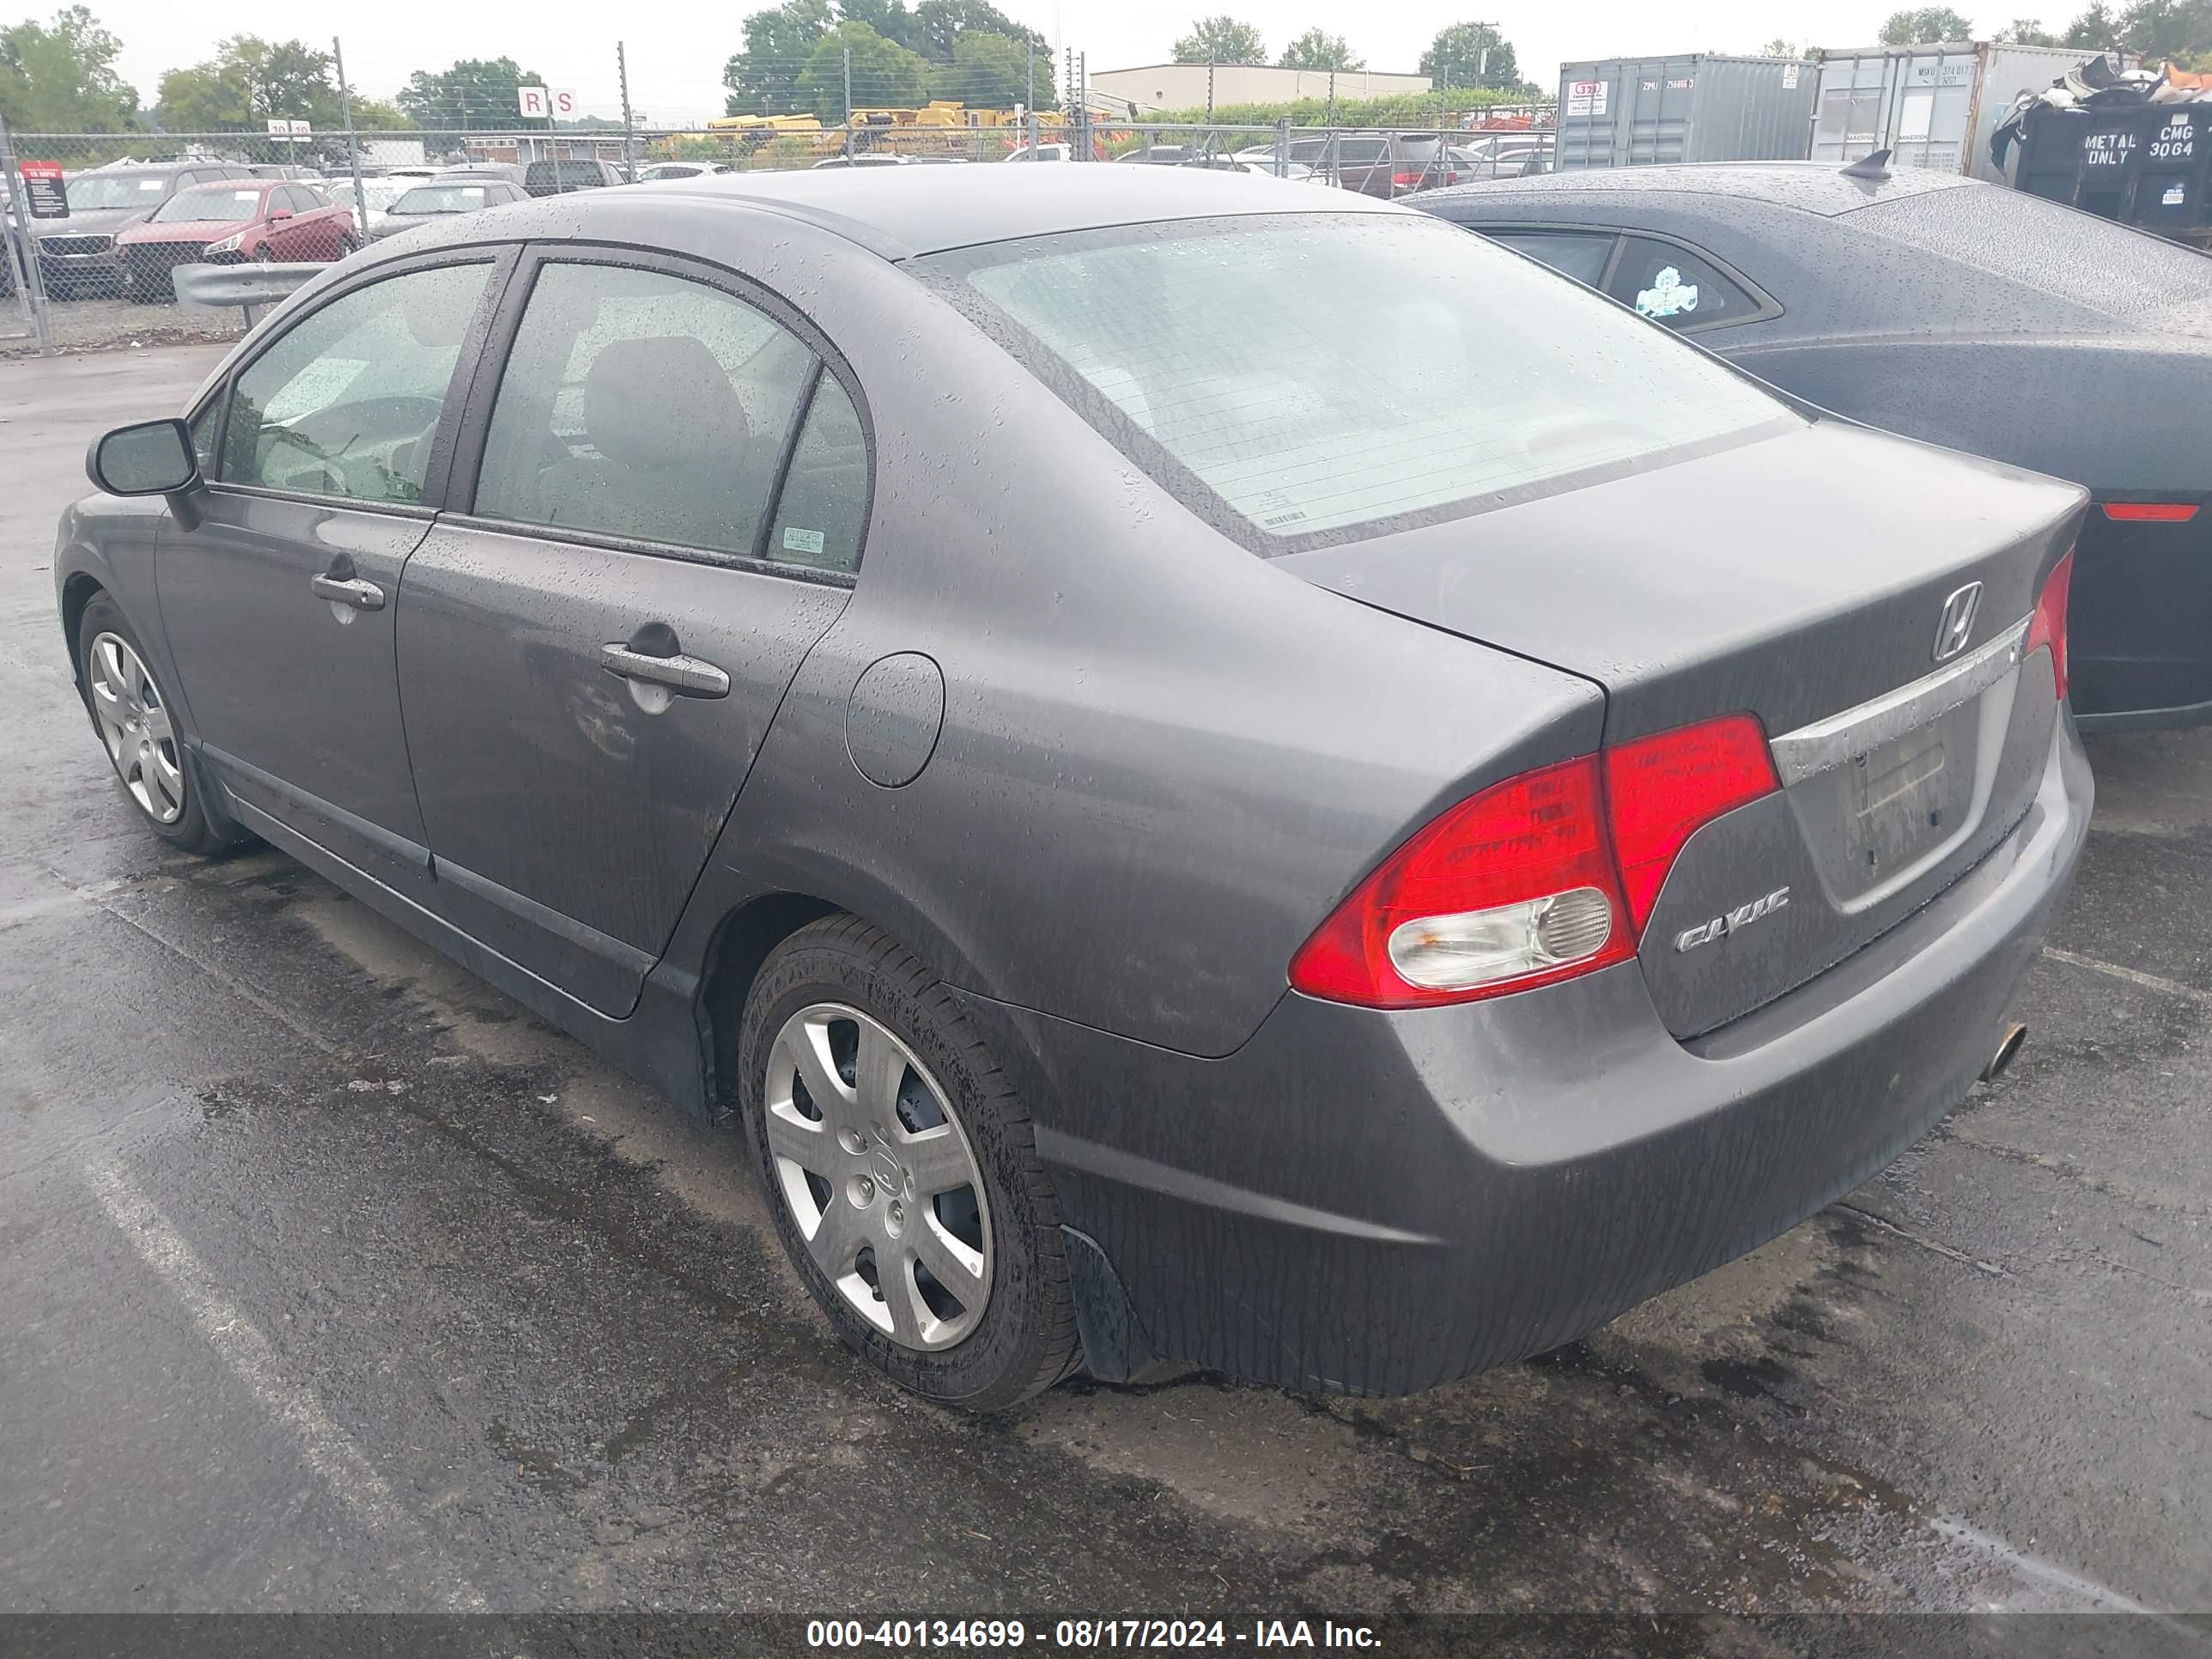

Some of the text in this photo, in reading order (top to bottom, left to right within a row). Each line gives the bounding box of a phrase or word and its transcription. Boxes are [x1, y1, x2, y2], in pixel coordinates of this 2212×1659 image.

[526, 93, 572, 112] R S
[2160, 125, 2193, 141] CMG
[2085, 134, 2136, 149] METAL
[2088, 150, 2128, 165] ONLY
